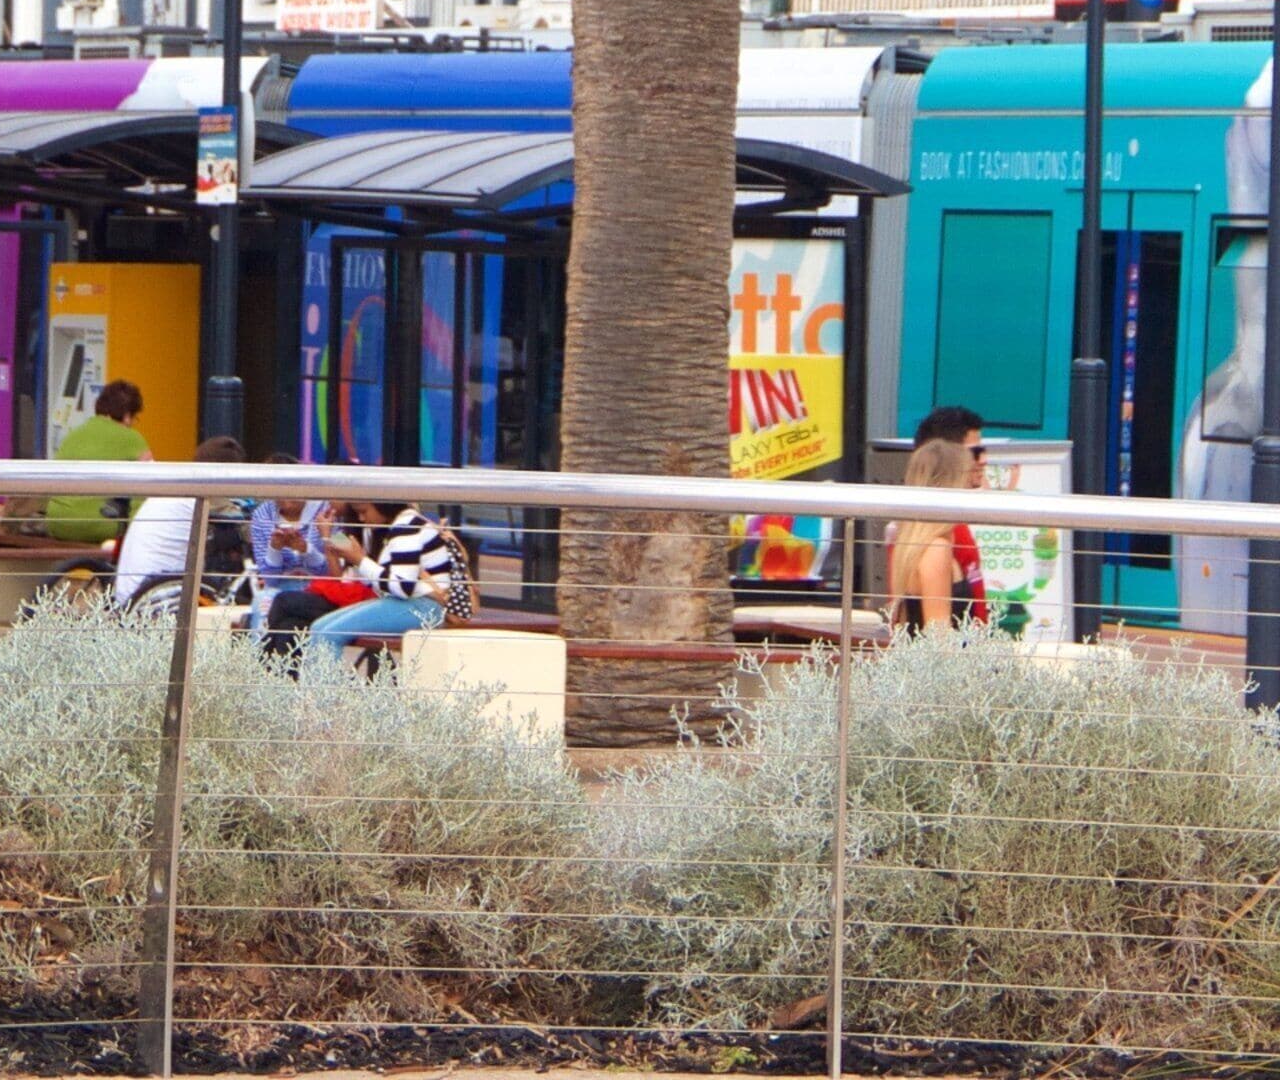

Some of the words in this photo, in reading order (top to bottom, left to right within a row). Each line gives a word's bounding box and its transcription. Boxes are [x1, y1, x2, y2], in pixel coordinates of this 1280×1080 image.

[920, 151, 950, 180] BOOK
[957, 151, 973, 179] AT
[978, 151, 1121, 181] FASHIONICONS.CAU
[811, 226, 847, 237] ADSHEL
[733, 272, 846, 355] tto
[775, 425, 811, 450] Tab
[754, 451, 788, 474] EVERY
[976, 530, 1012, 542] FOOD
[1017, 530, 1029, 542] IS
[1002, 557, 1024, 570] GO
